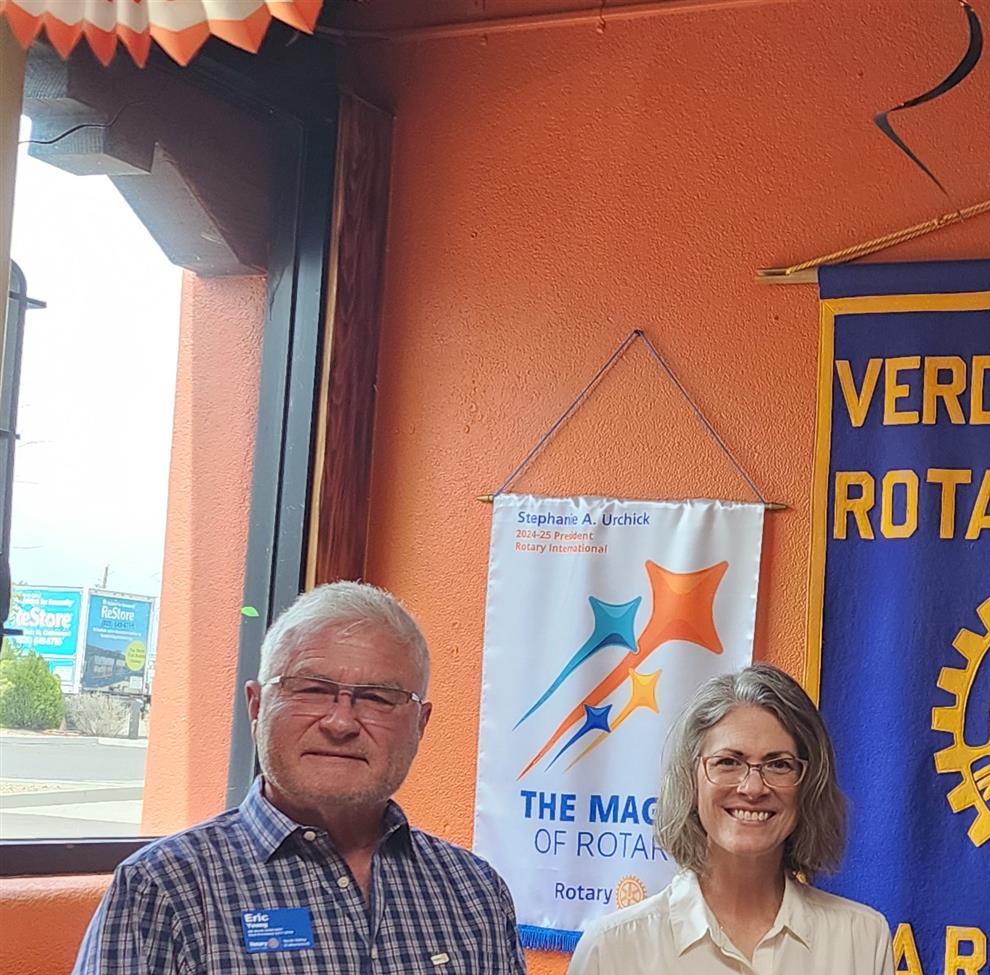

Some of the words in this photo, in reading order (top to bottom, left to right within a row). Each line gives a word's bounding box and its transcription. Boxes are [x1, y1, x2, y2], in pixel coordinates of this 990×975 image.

[581, 513, 597, 525] A.
[602, 511, 650, 526] Urchick
[515, 530, 551, 539] 2024-25
[515, 541, 546, 553] Rotary
[548, 543, 608, 554] International
[101, 605, 135, 621] ReStore
[520, 790, 577, 823] THE
[534, 828, 567, 856] OF
[554, 882, 613, 905] Rotary
[244, 913, 269, 922] Eric
